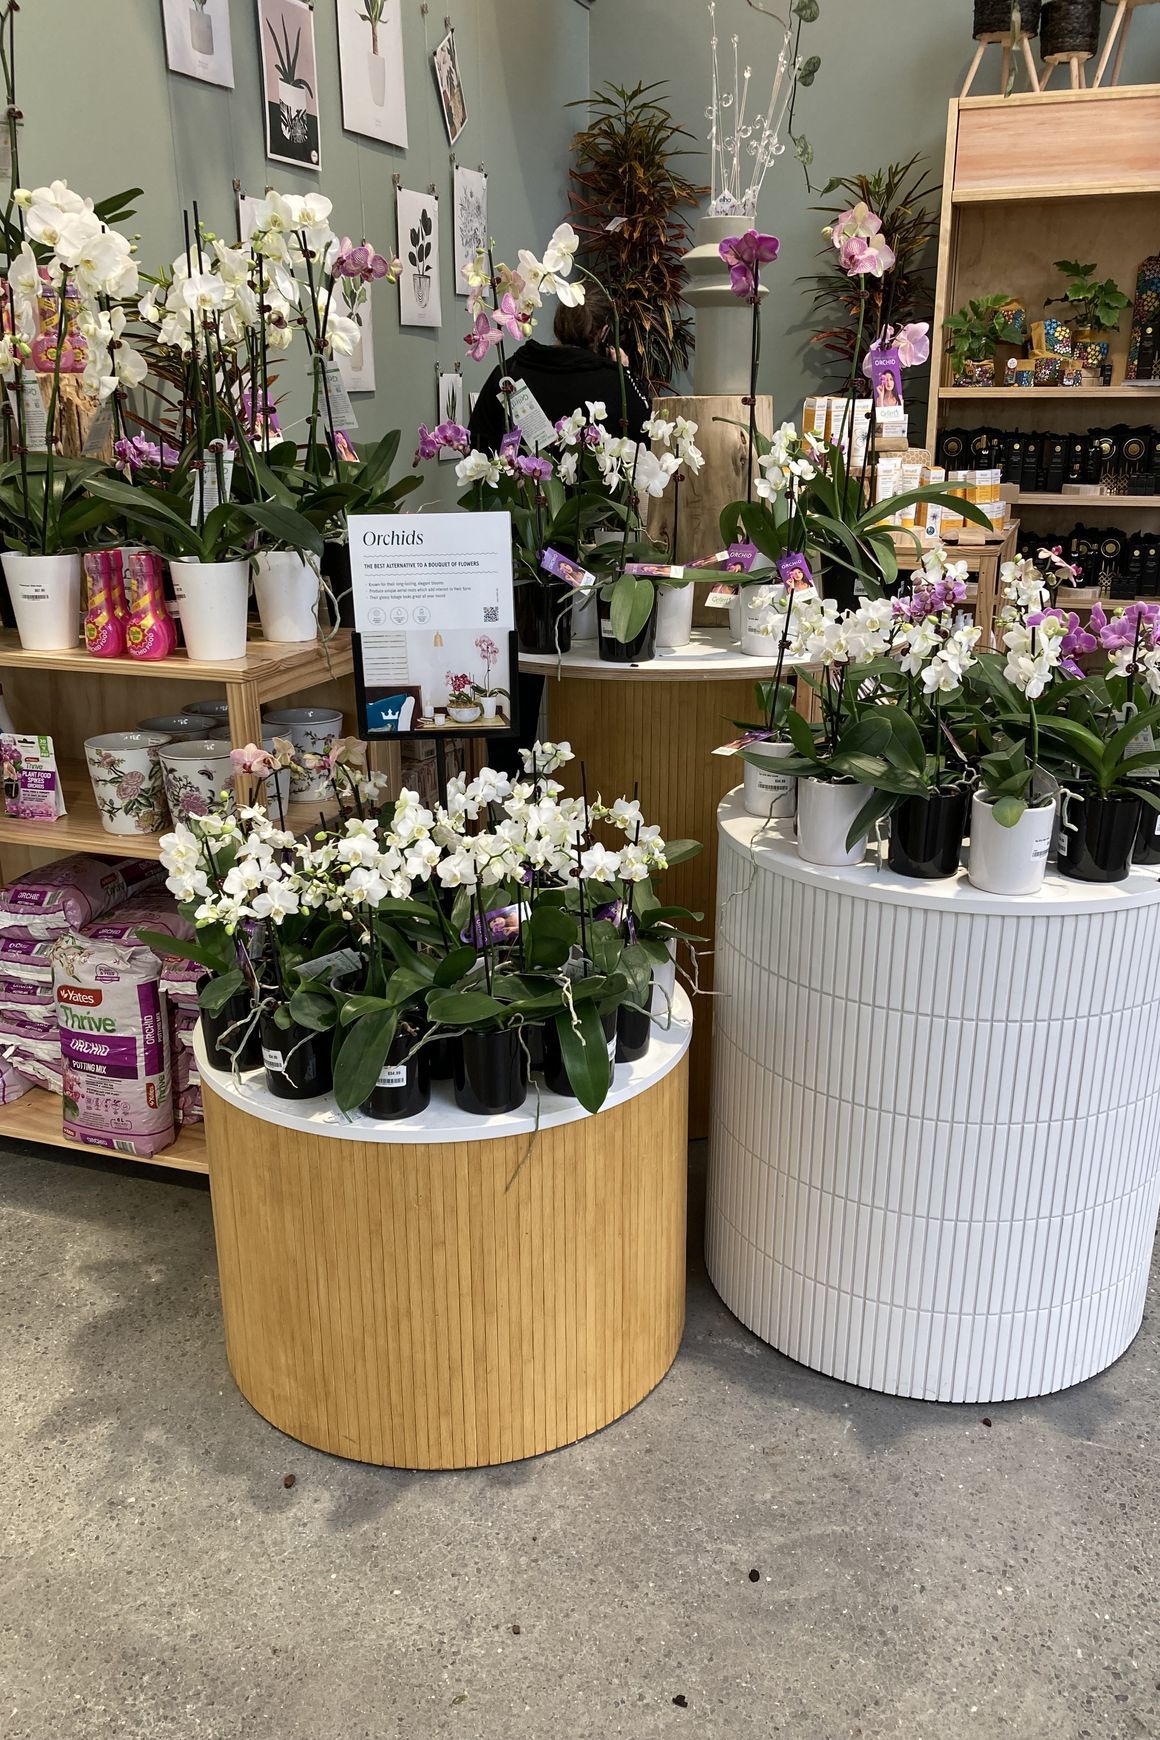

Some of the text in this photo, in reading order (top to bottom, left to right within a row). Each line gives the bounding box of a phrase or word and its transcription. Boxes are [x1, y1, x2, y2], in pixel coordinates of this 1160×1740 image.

[362, 529, 424, 547] Orchids
[729, 551, 753, 559] ORCHID
[781, 559, 802, 570] ORCHID
[100, 629, 108, 646] FOOD
[146, 632, 154, 650] FOOD
[22, 770, 37, 778] PLANT
[67, 989, 94, 1004] Yates
[60, 1004, 117, 1034] Thrive
[143, 1014, 155, 1045] ORCHID
[70, 1038, 110, 1056] ORCHID
[72, 1060, 107, 1074] POTTING MIX
